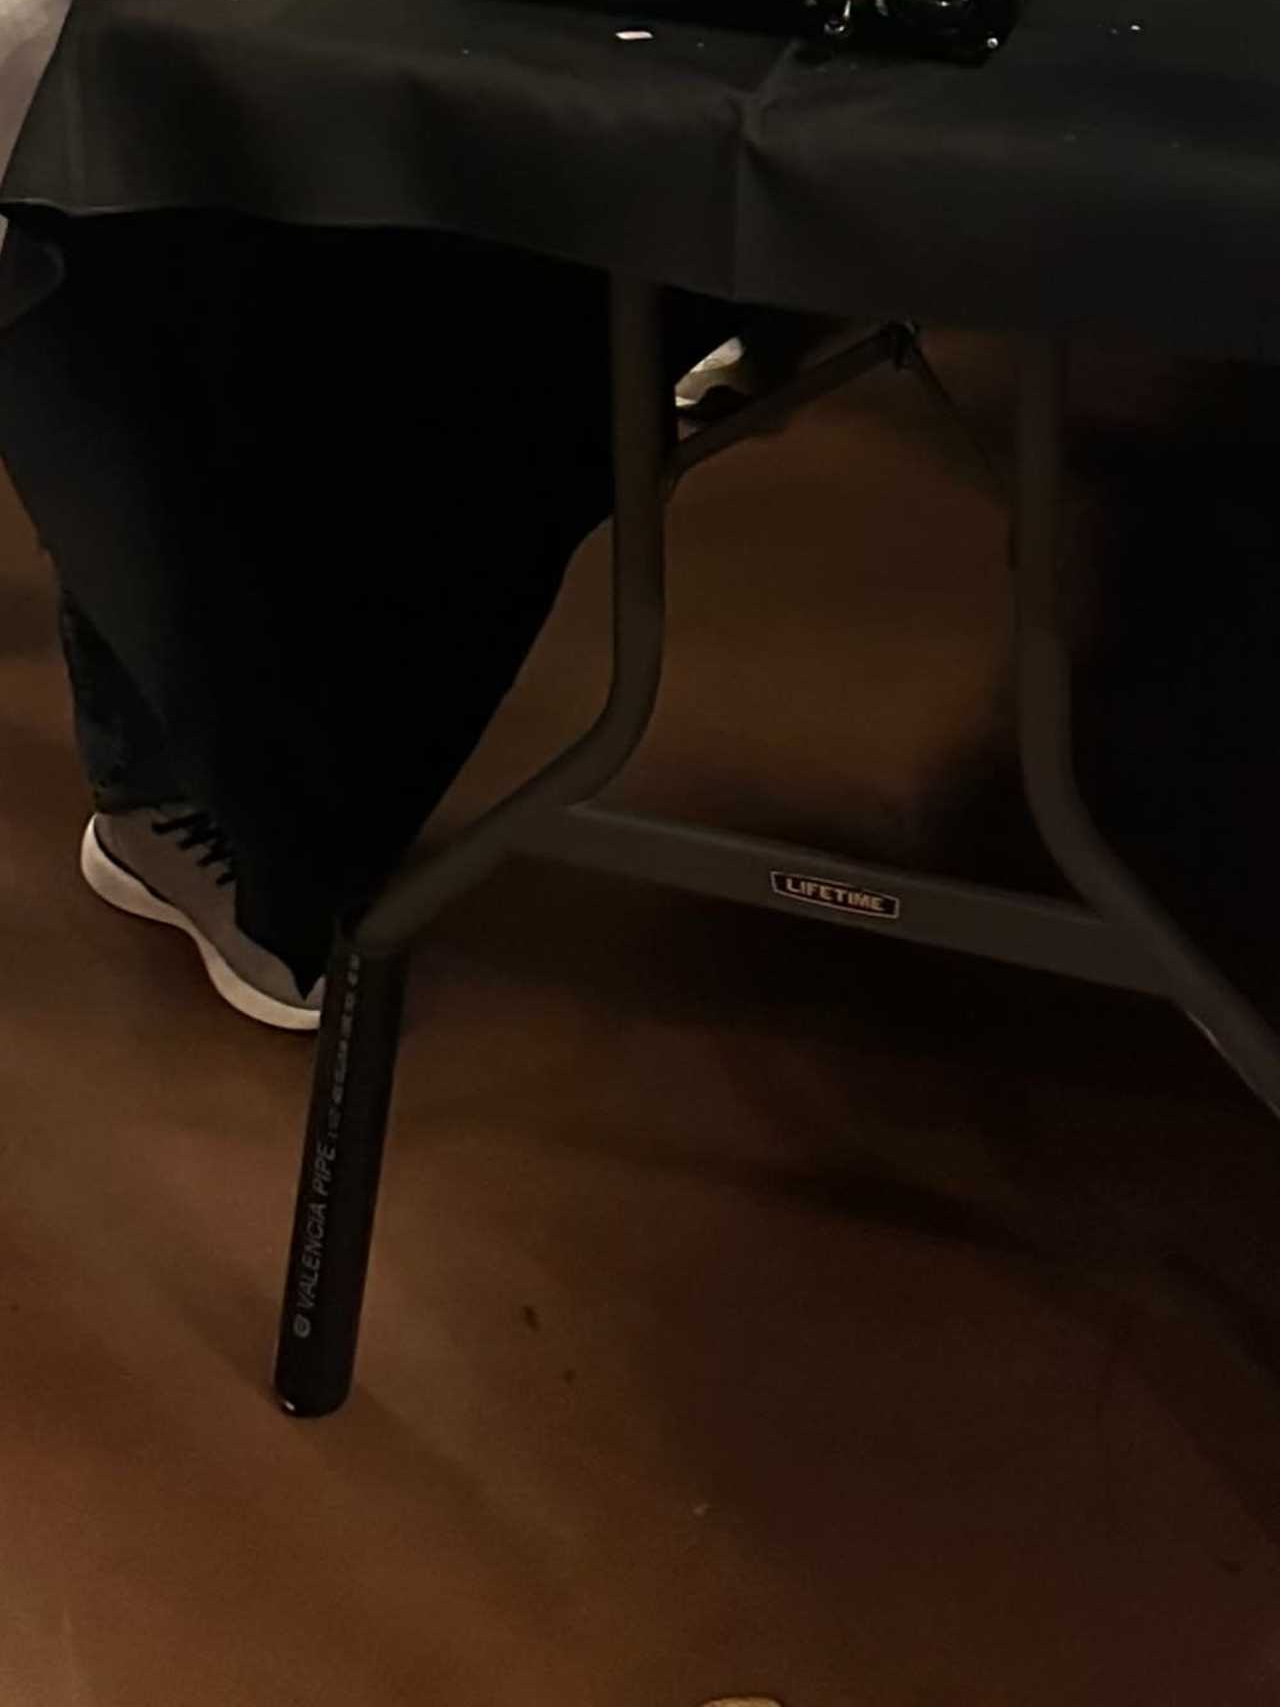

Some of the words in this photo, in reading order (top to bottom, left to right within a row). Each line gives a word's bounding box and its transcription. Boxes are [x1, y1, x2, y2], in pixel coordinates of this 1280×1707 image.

[786, 878, 884, 911] LIFETIME
[296, 1203, 327, 1309] VALENCIA
[312, 1144, 336, 1195] PIPE
